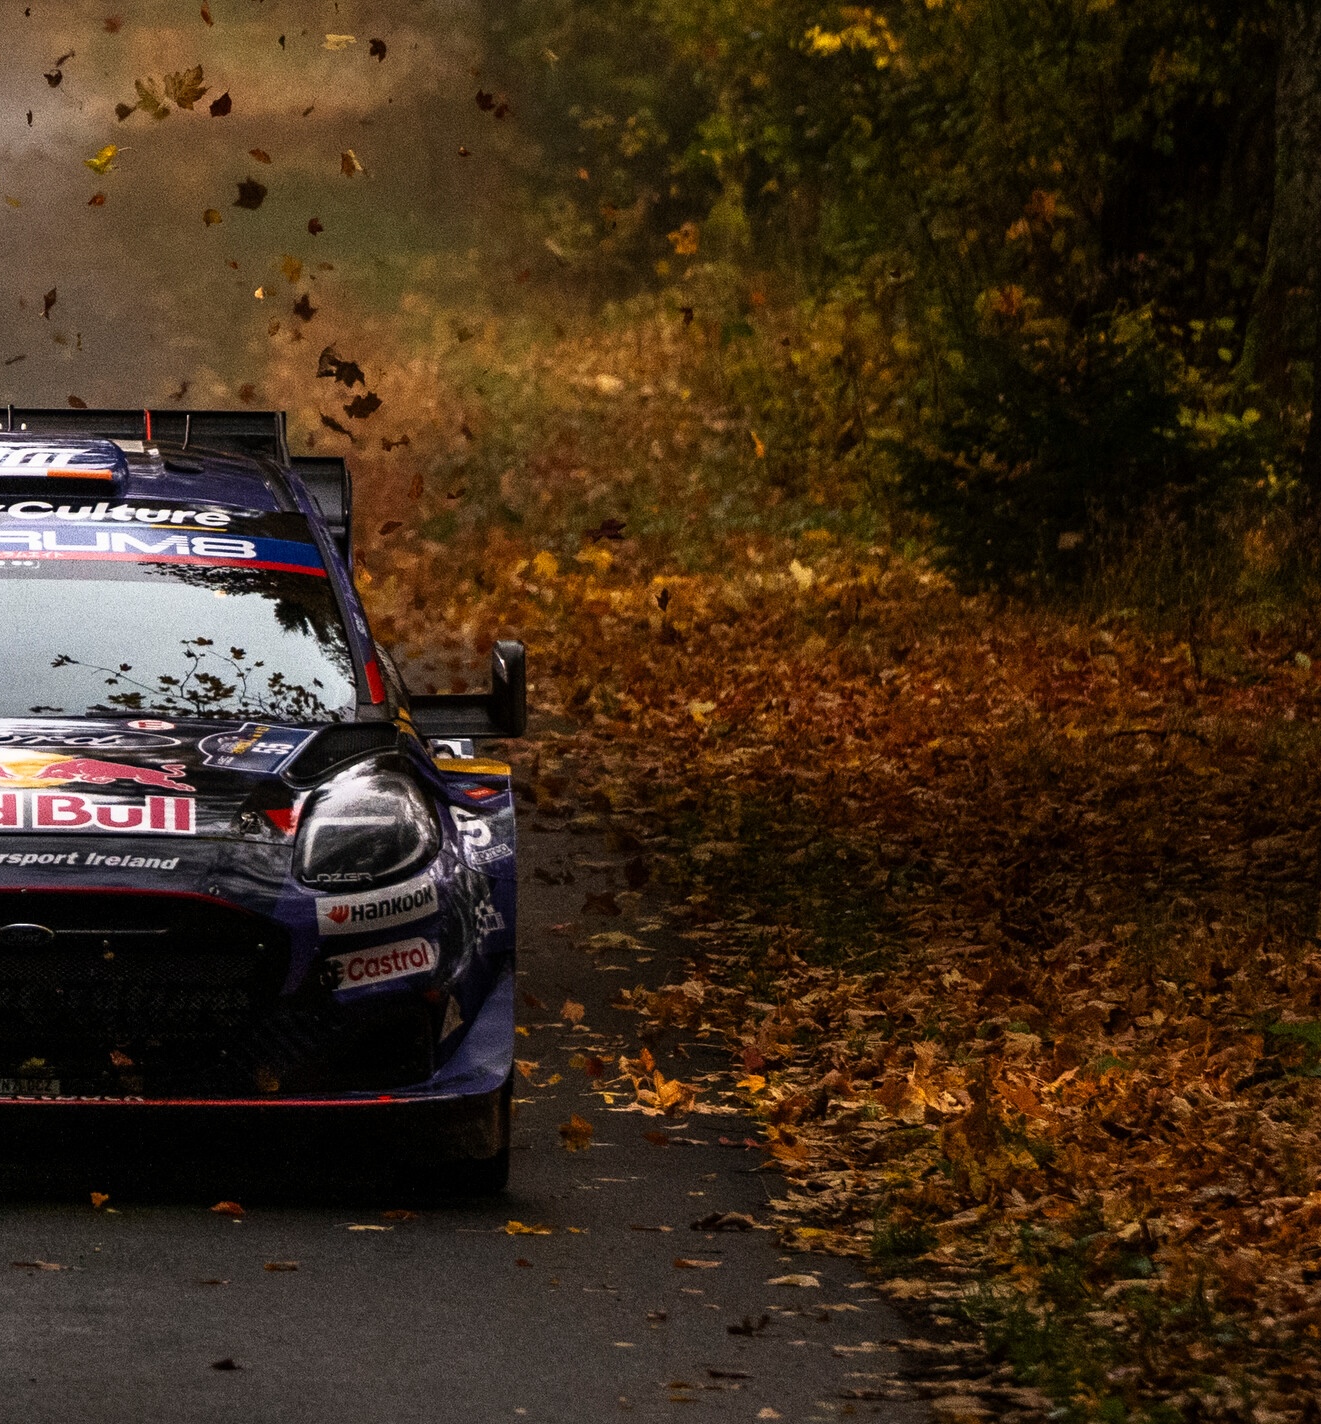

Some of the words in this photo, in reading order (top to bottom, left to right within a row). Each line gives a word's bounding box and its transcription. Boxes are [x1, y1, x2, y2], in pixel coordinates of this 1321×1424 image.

[35, 795, 192, 832] Bull
[85, 852, 180, 870] Ireland
[347, 942, 430, 981] Castrol
